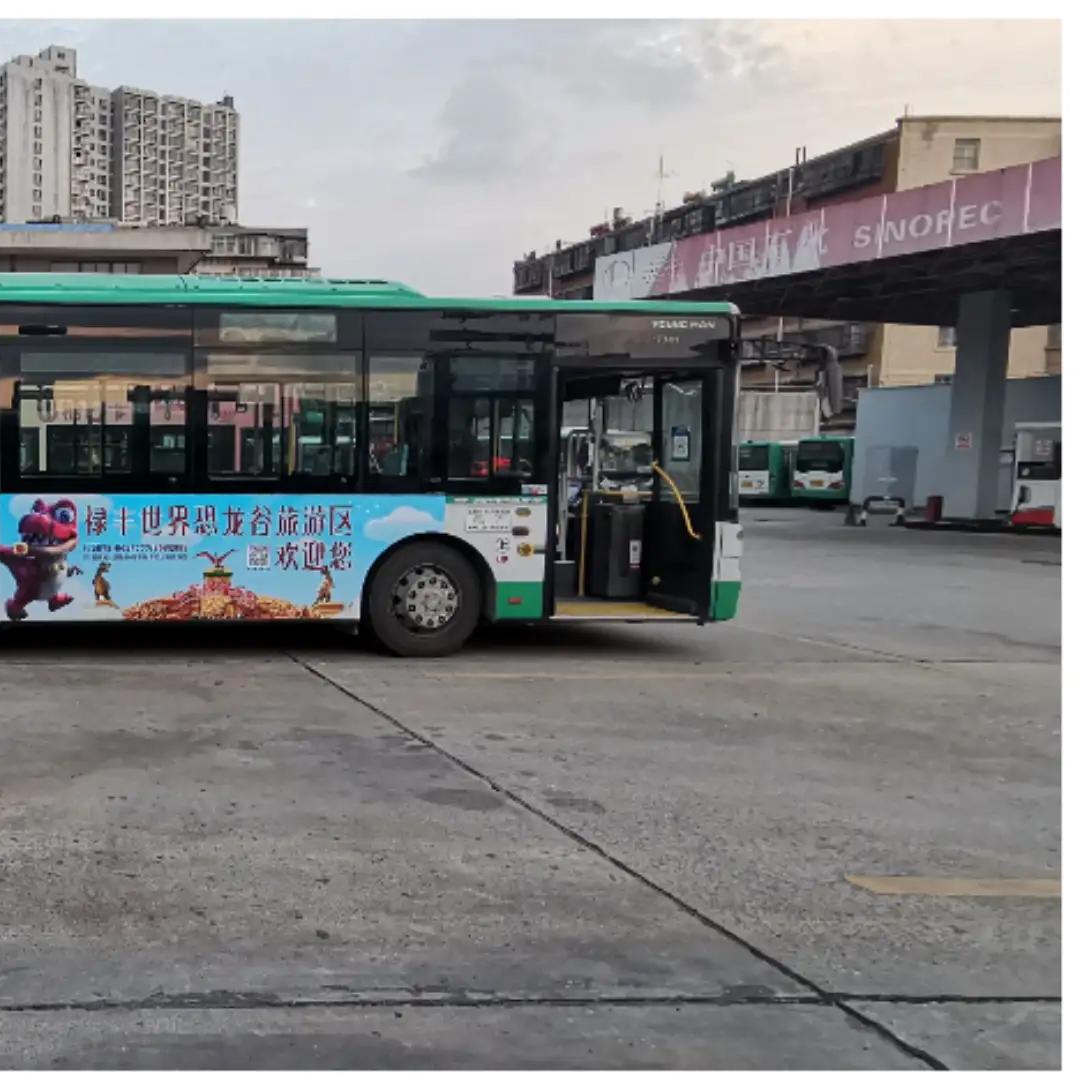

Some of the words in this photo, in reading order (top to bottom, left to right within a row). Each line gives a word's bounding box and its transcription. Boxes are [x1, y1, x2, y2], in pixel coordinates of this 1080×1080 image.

[853, 200, 1001, 248] SINOPEC
[84, 504, 353, 537] 禄丰世界恐龙谷旅游区
[275, 540, 353, 571] 欢迎您
